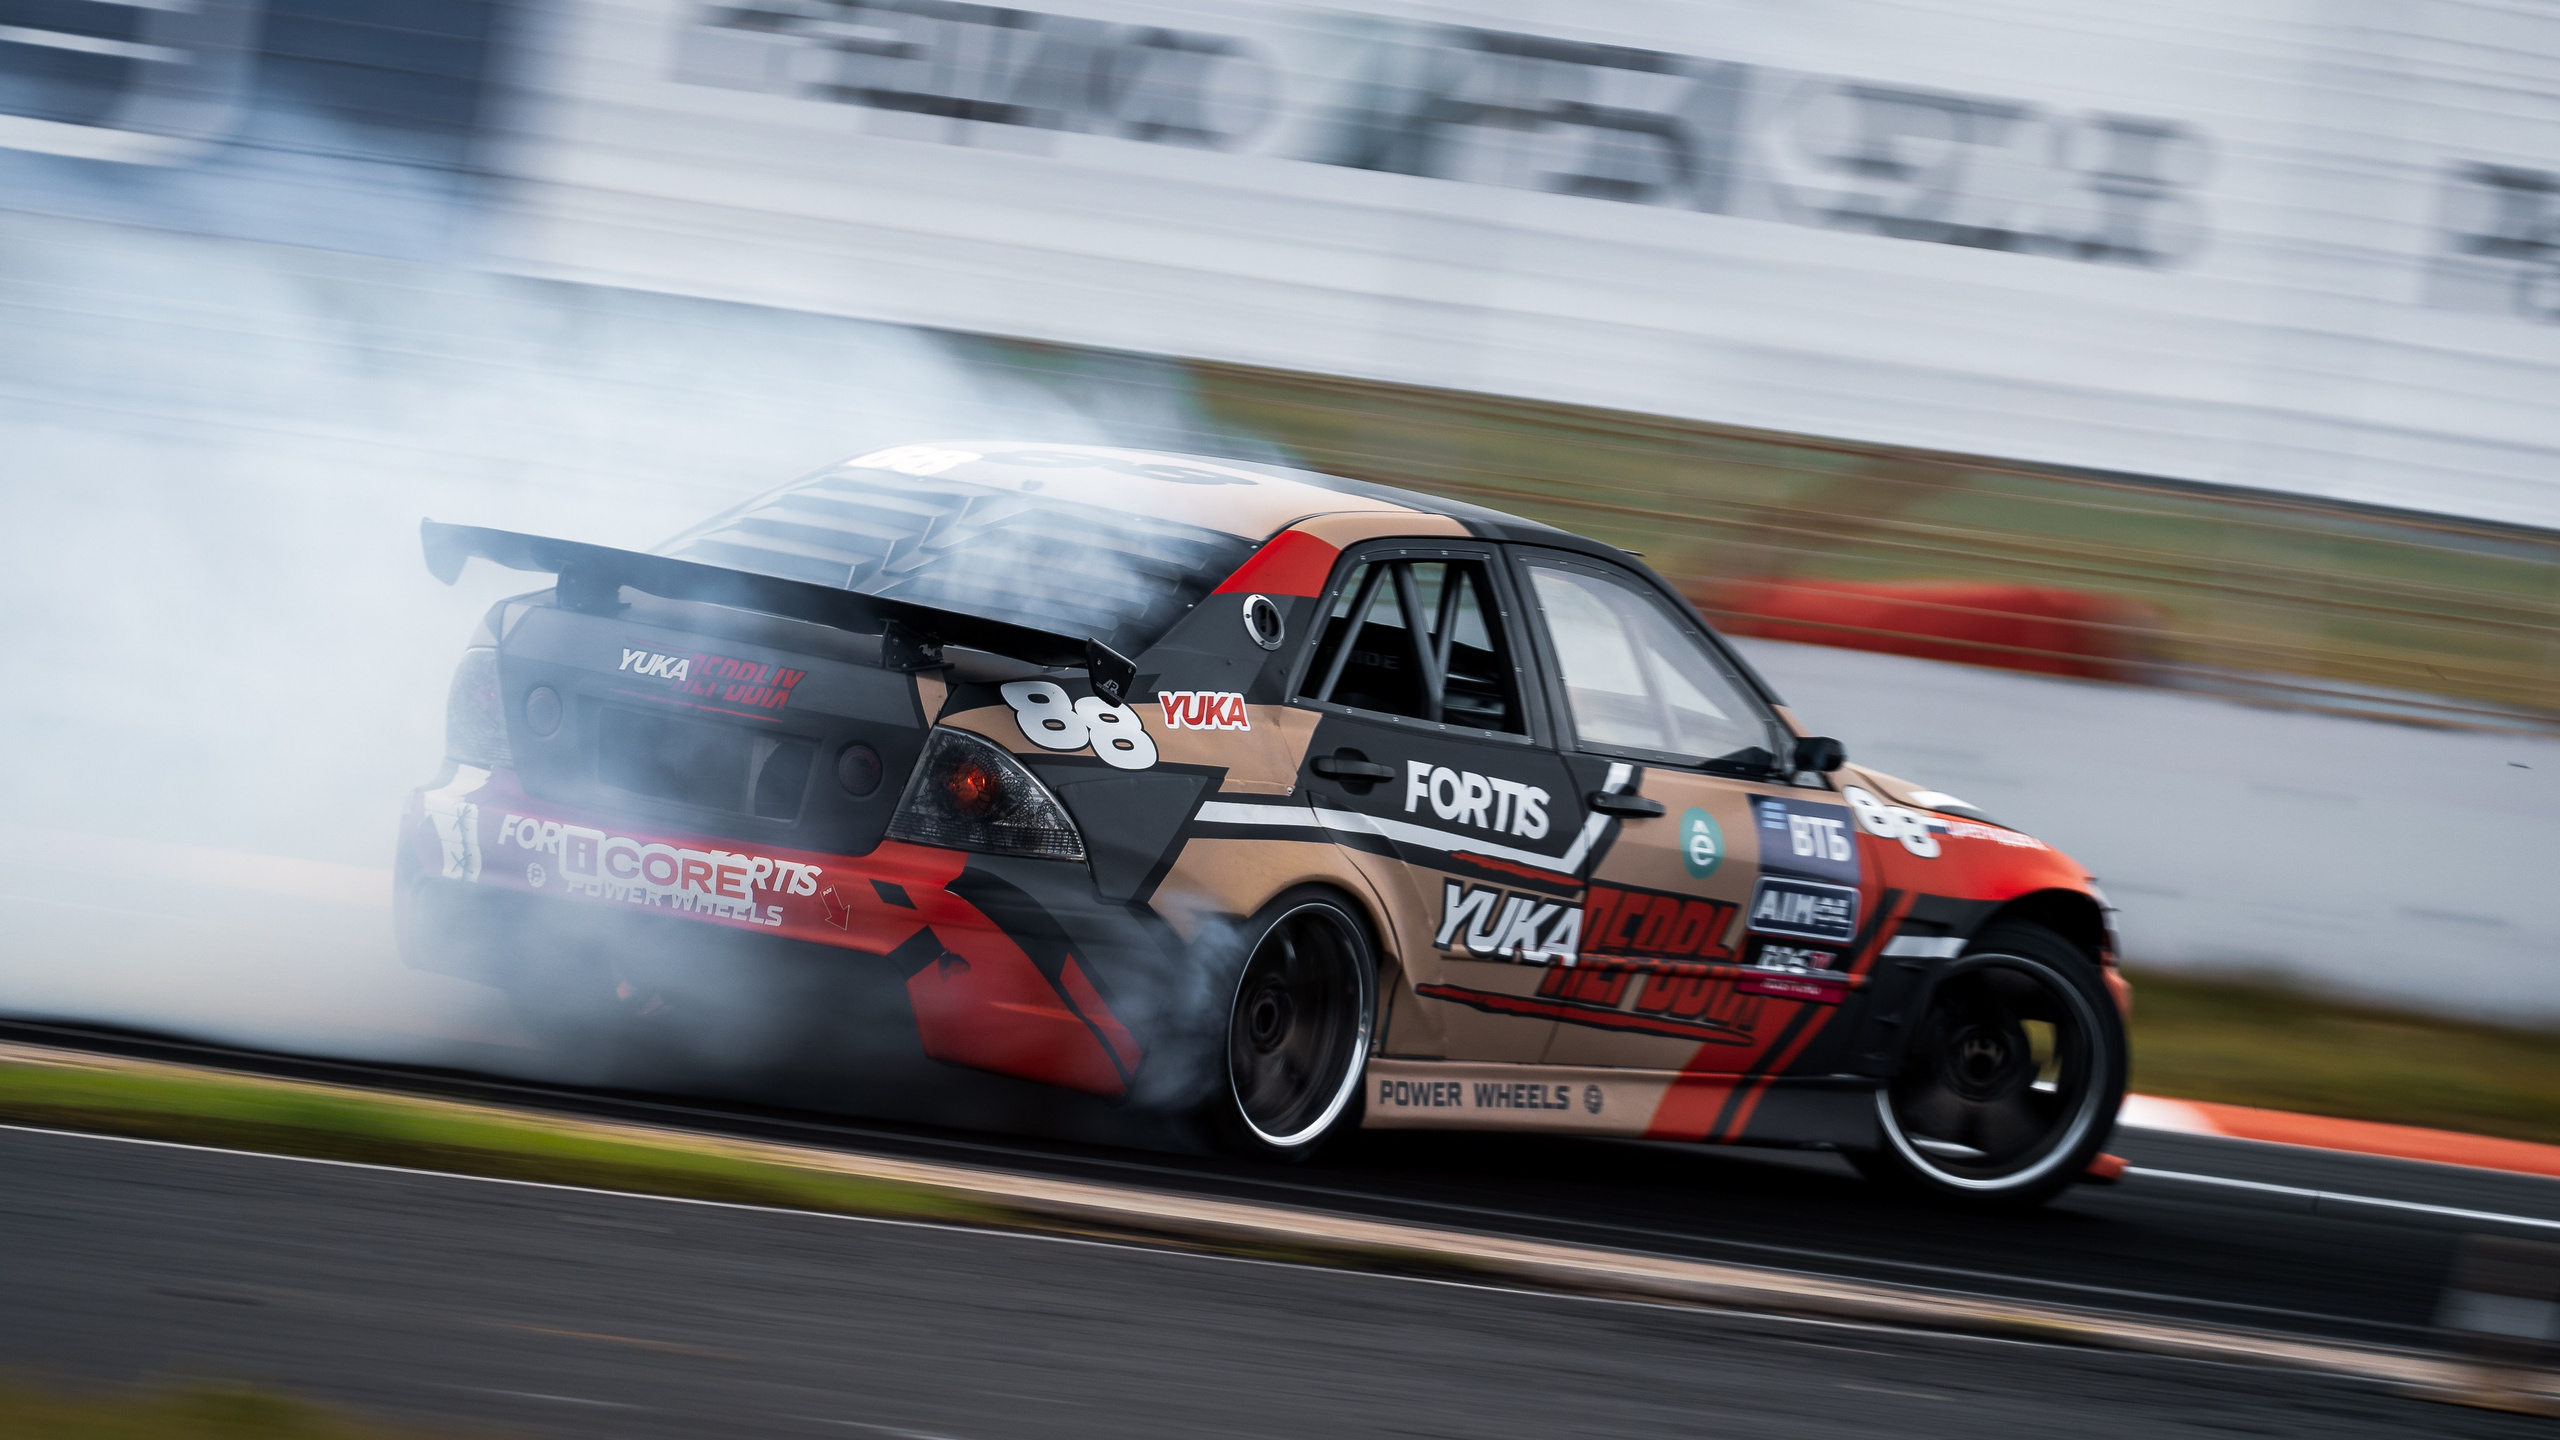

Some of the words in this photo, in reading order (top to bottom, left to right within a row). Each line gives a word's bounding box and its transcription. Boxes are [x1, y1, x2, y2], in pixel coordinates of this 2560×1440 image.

[619, 648, 690, 682] YUKA
[1000, 680, 1159, 770] 88
[1160, 693, 1249, 730] YUKA
[1405, 760, 1551, 840] FORTIS
[1842, 785, 1941, 858] 88
[1436, 882, 1584, 967] YUKA
[1379, 1080, 1462, 1107] POWER
[1473, 1082, 1571, 1110] WHEELS
